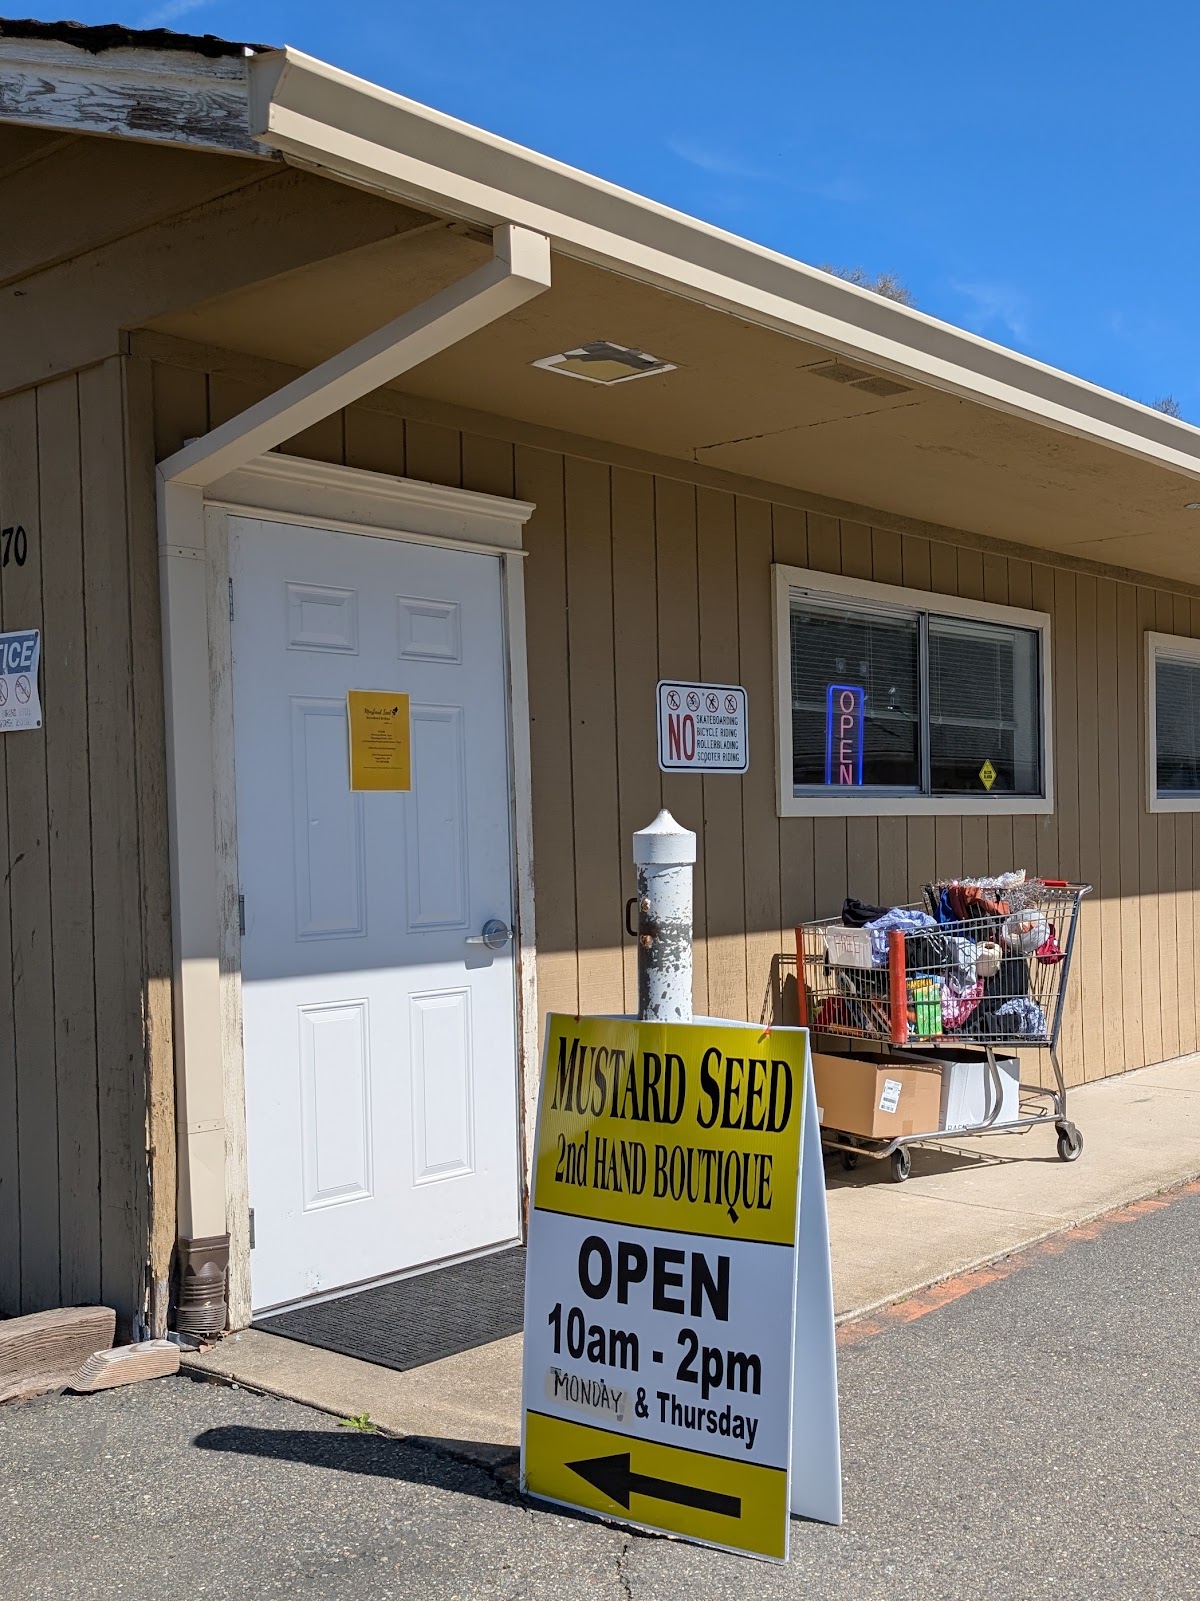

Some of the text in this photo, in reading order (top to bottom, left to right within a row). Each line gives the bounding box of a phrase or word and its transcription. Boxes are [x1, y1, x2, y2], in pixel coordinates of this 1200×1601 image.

[2, 526, 27, 567] 70
[0, 640, 34, 669] ICE
[668, 713, 695, 761] NO
[696, 714, 738, 726] SKATEBOARDING
[696, 727, 738, 738] BICYCLE RIDING
[839, 690, 855, 785] OPEN
[696, 739, 739, 750] ROLLERBLADING
[697, 751, 740, 762] SCOOTER RIDING
[833, 934, 860, 954] FREE
[551, 1036, 793, 1133] MUSTARD SEED
[554, 1130, 773, 1224] 2nd HAND BOUTIQUE
[578, 1235, 730, 1322] OPEN
[548, 1302, 762, 1400] 10am - 2pm
[553, 1369, 759, 1450] MONDAY & Thursday
